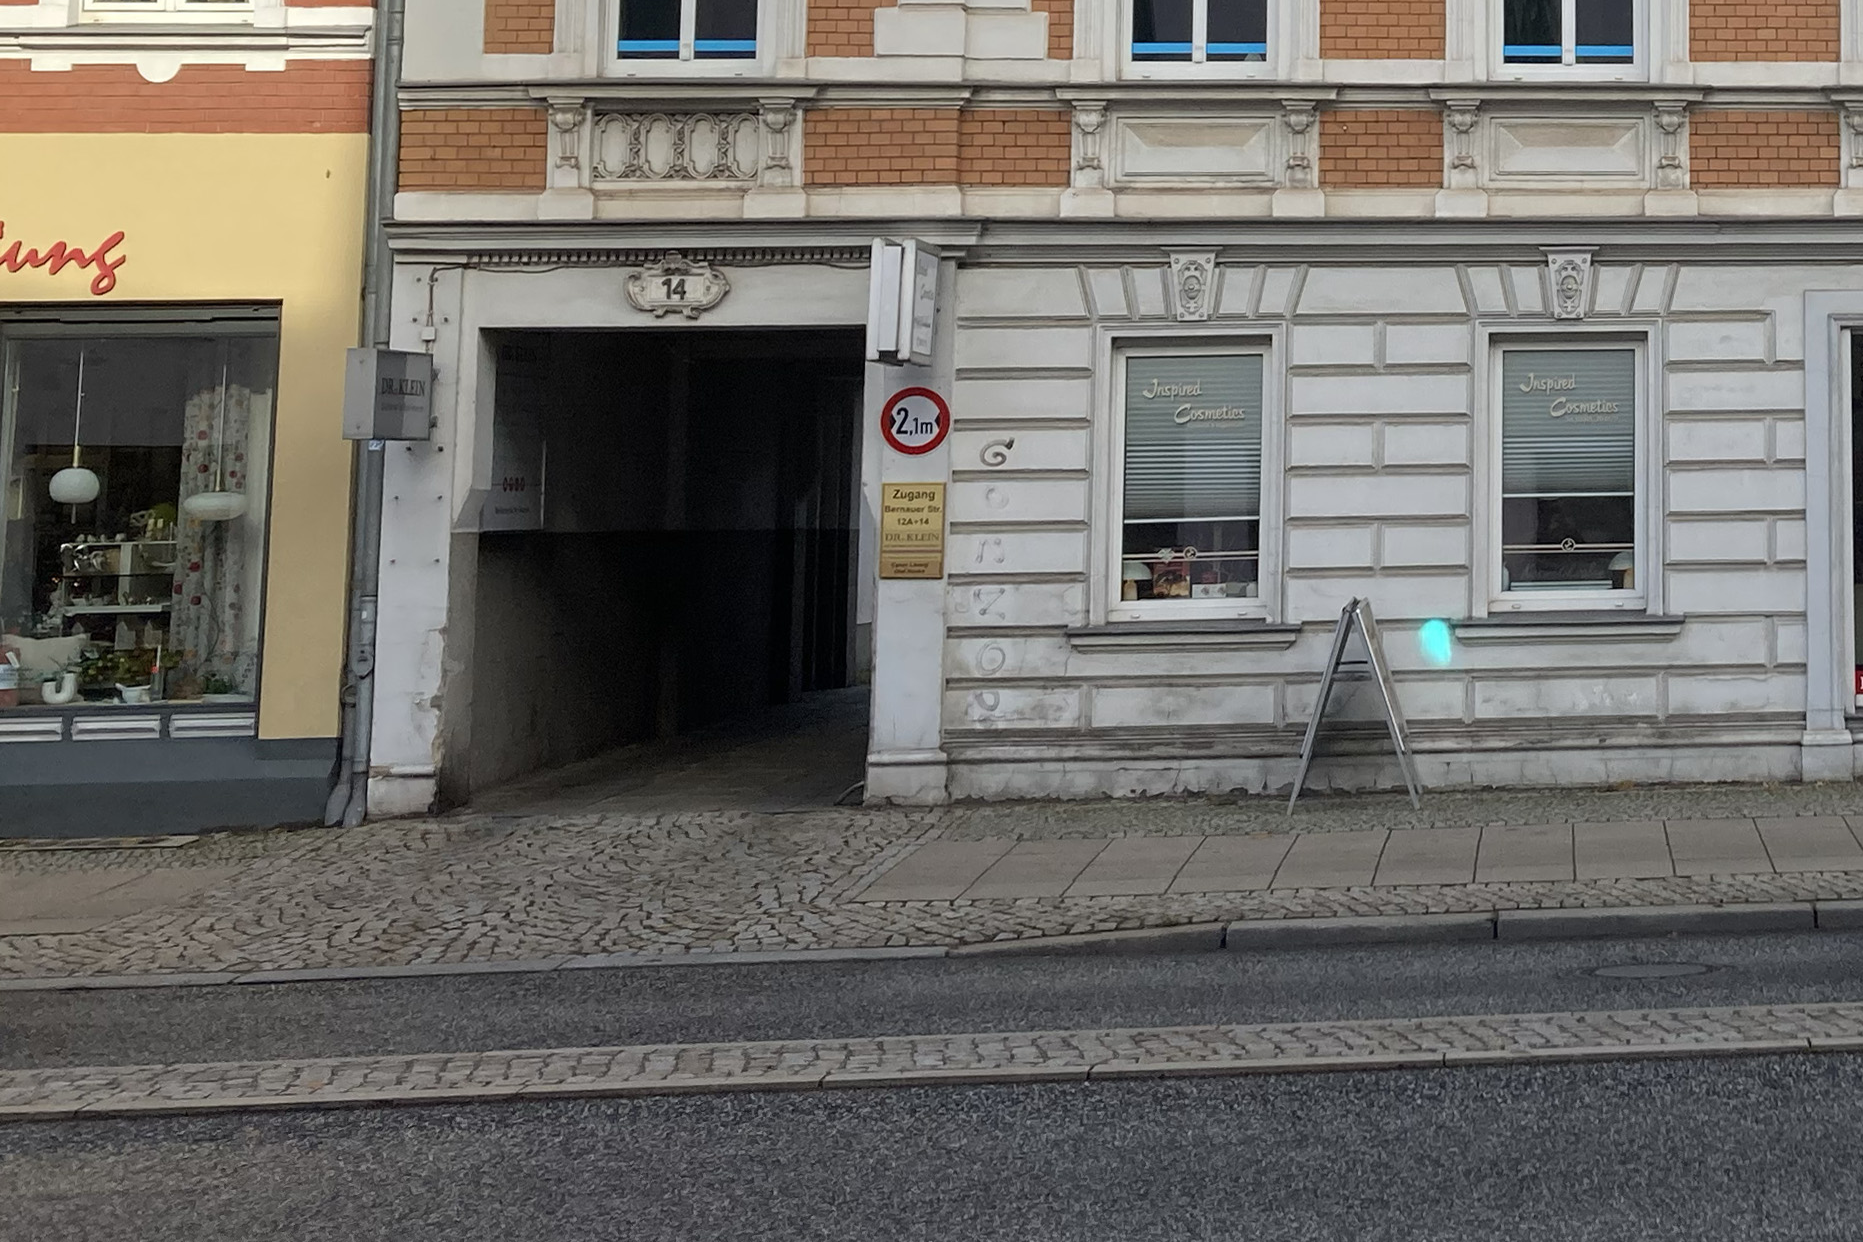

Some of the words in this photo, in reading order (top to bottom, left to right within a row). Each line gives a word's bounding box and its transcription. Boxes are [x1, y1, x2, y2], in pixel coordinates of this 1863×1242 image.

[0, 221, 126, 295] ung
[661, 277, 686, 300] 14
[399, 378, 426, 397] KLEIN
[1142, 378, 1203, 401] Inspired
[1519, 372, 1577, 395] Inspired
[1173, 403, 1246, 425] Cosmetics
[1549, 397, 1619, 417] Cosmetics
[896, 407, 933, 436] 2,1m
[892, 489, 936, 502] Zugang
[884, 505, 925, 513] Bernauer
[927, 505, 943, 513] Str.
[906, 533, 940, 542] KLEIN
